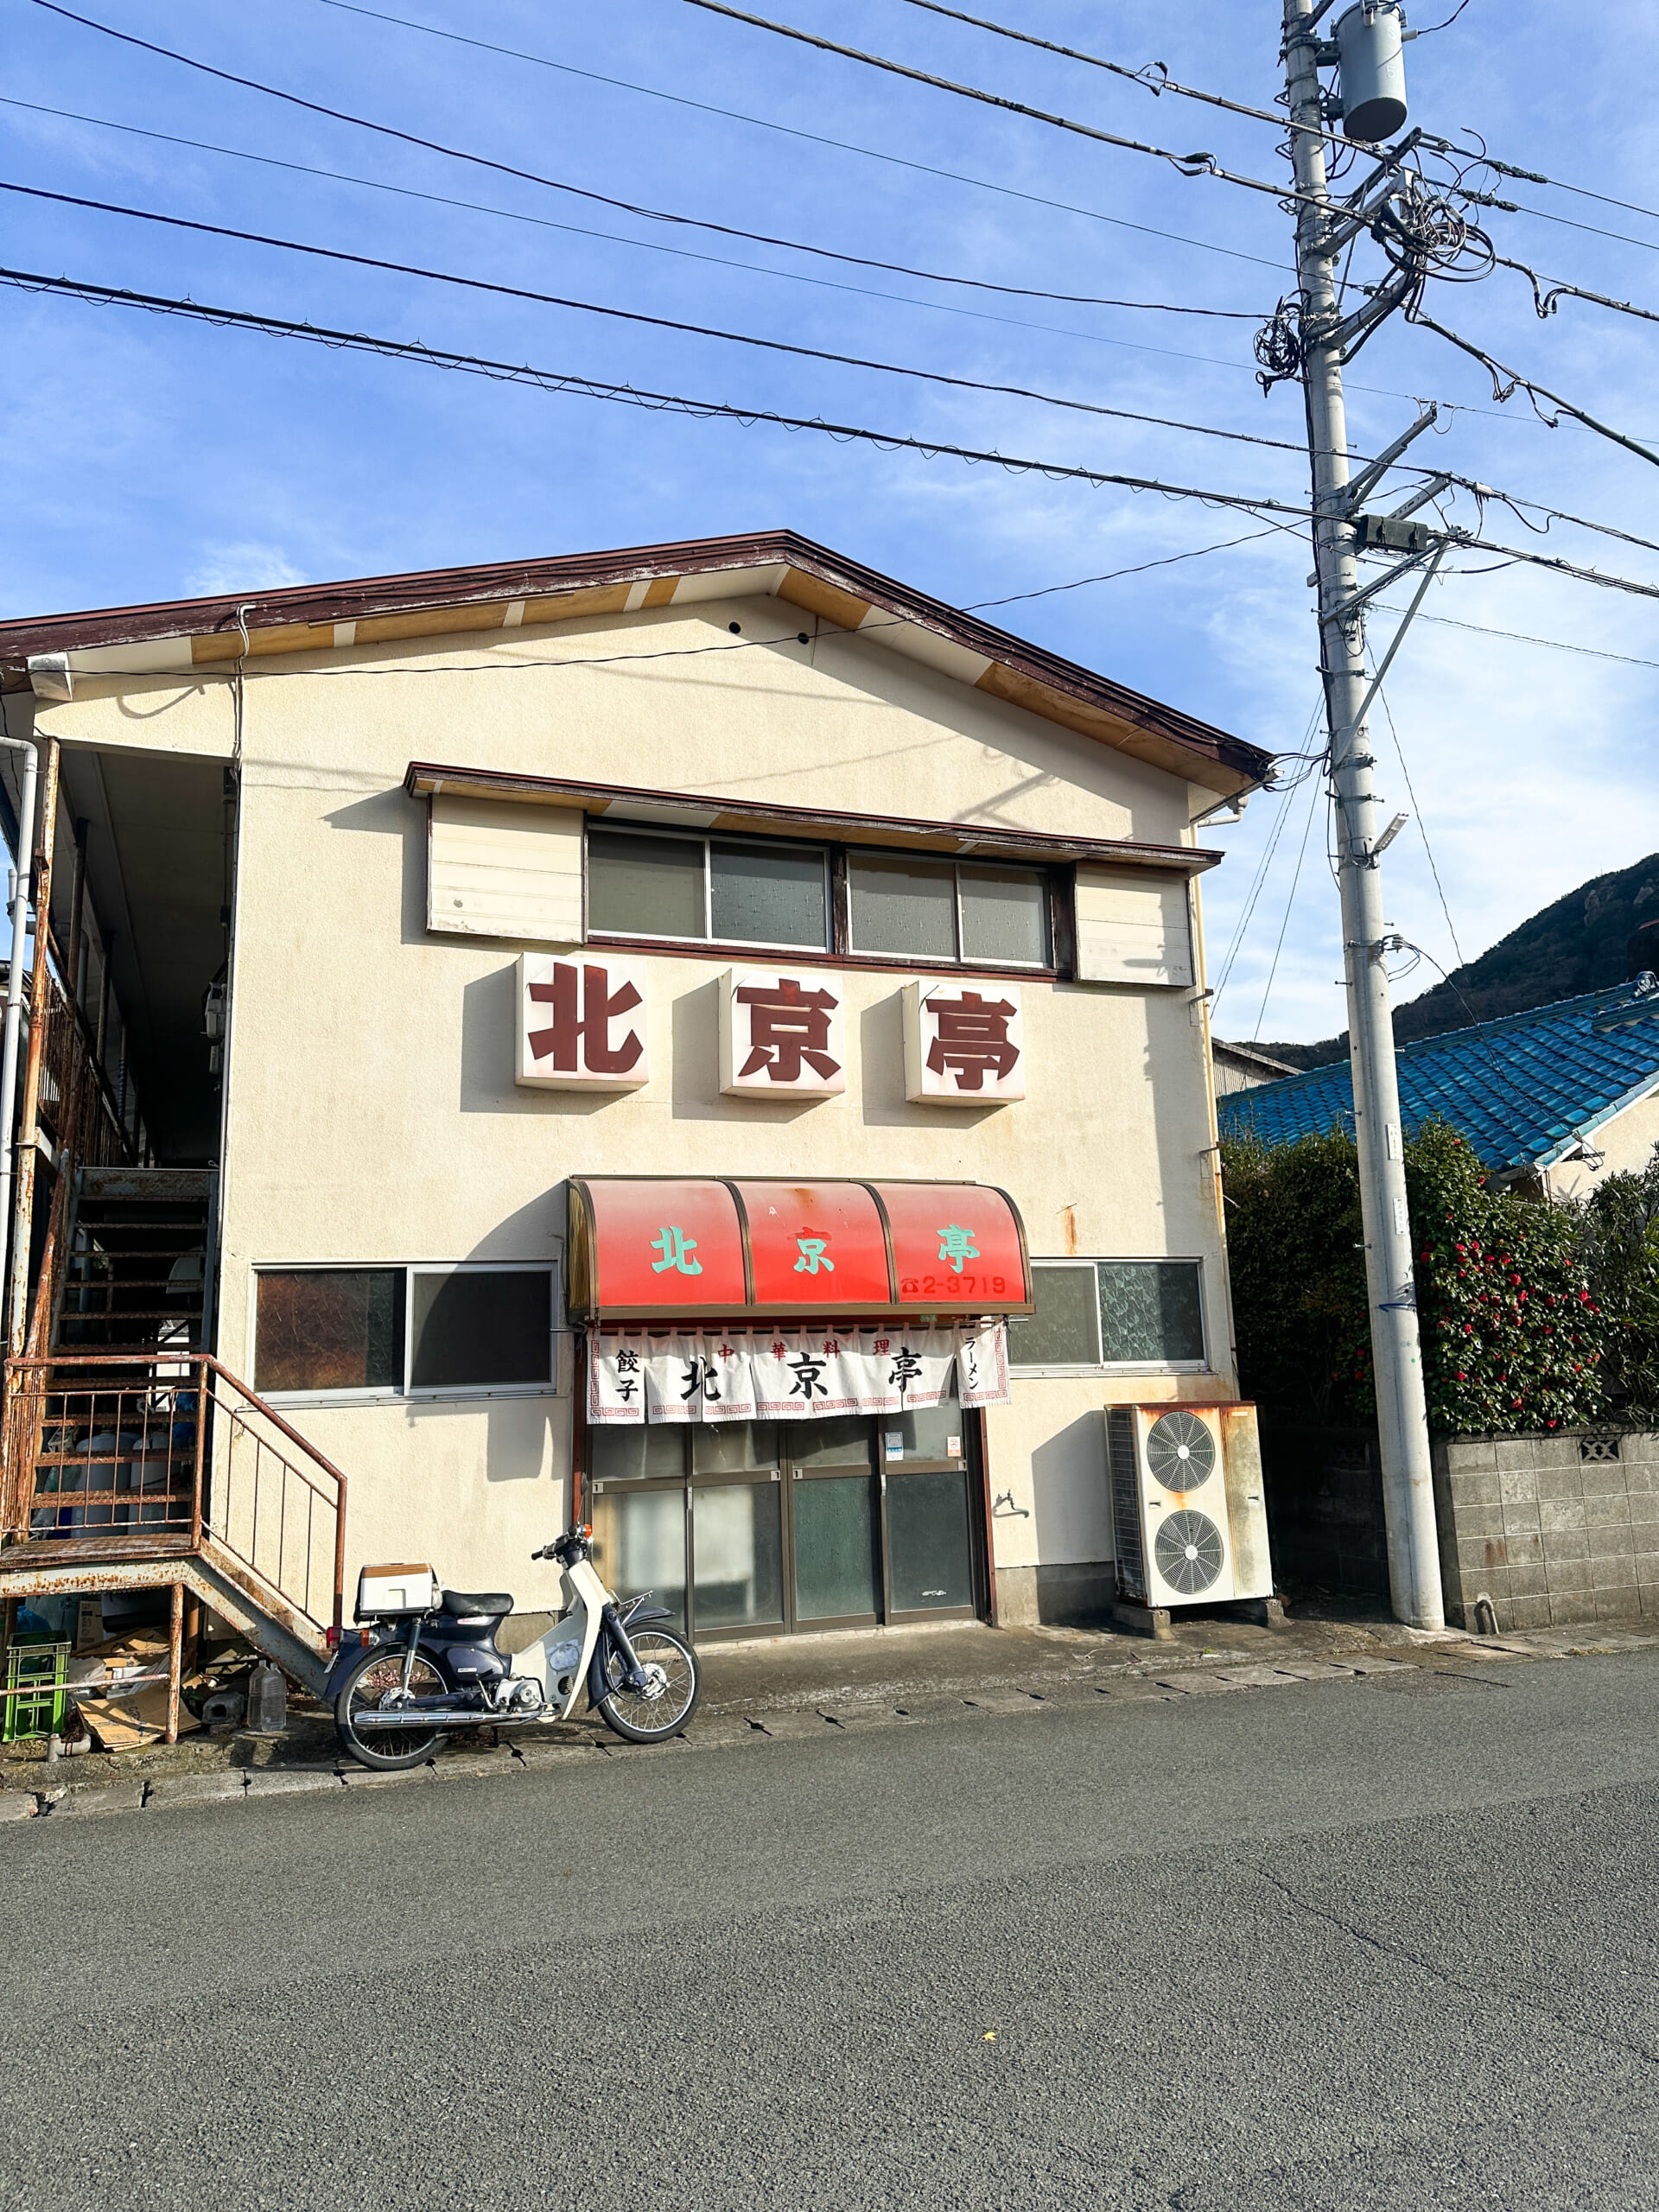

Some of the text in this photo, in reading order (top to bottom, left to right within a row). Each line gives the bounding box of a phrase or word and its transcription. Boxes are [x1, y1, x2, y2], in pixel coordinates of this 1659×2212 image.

[528, 962, 1020, 1090] 北京亭
[650, 1224, 980, 1276] 北京亭
[922, 1275, 1006, 1294] 2-3719
[615, 1350, 640, 1402] 餃子
[680, 1346, 923, 1402] 北京亭
[717, 1338, 891, 1364] 中華料理
[965, 1337, 979, 1390] ラーメン
